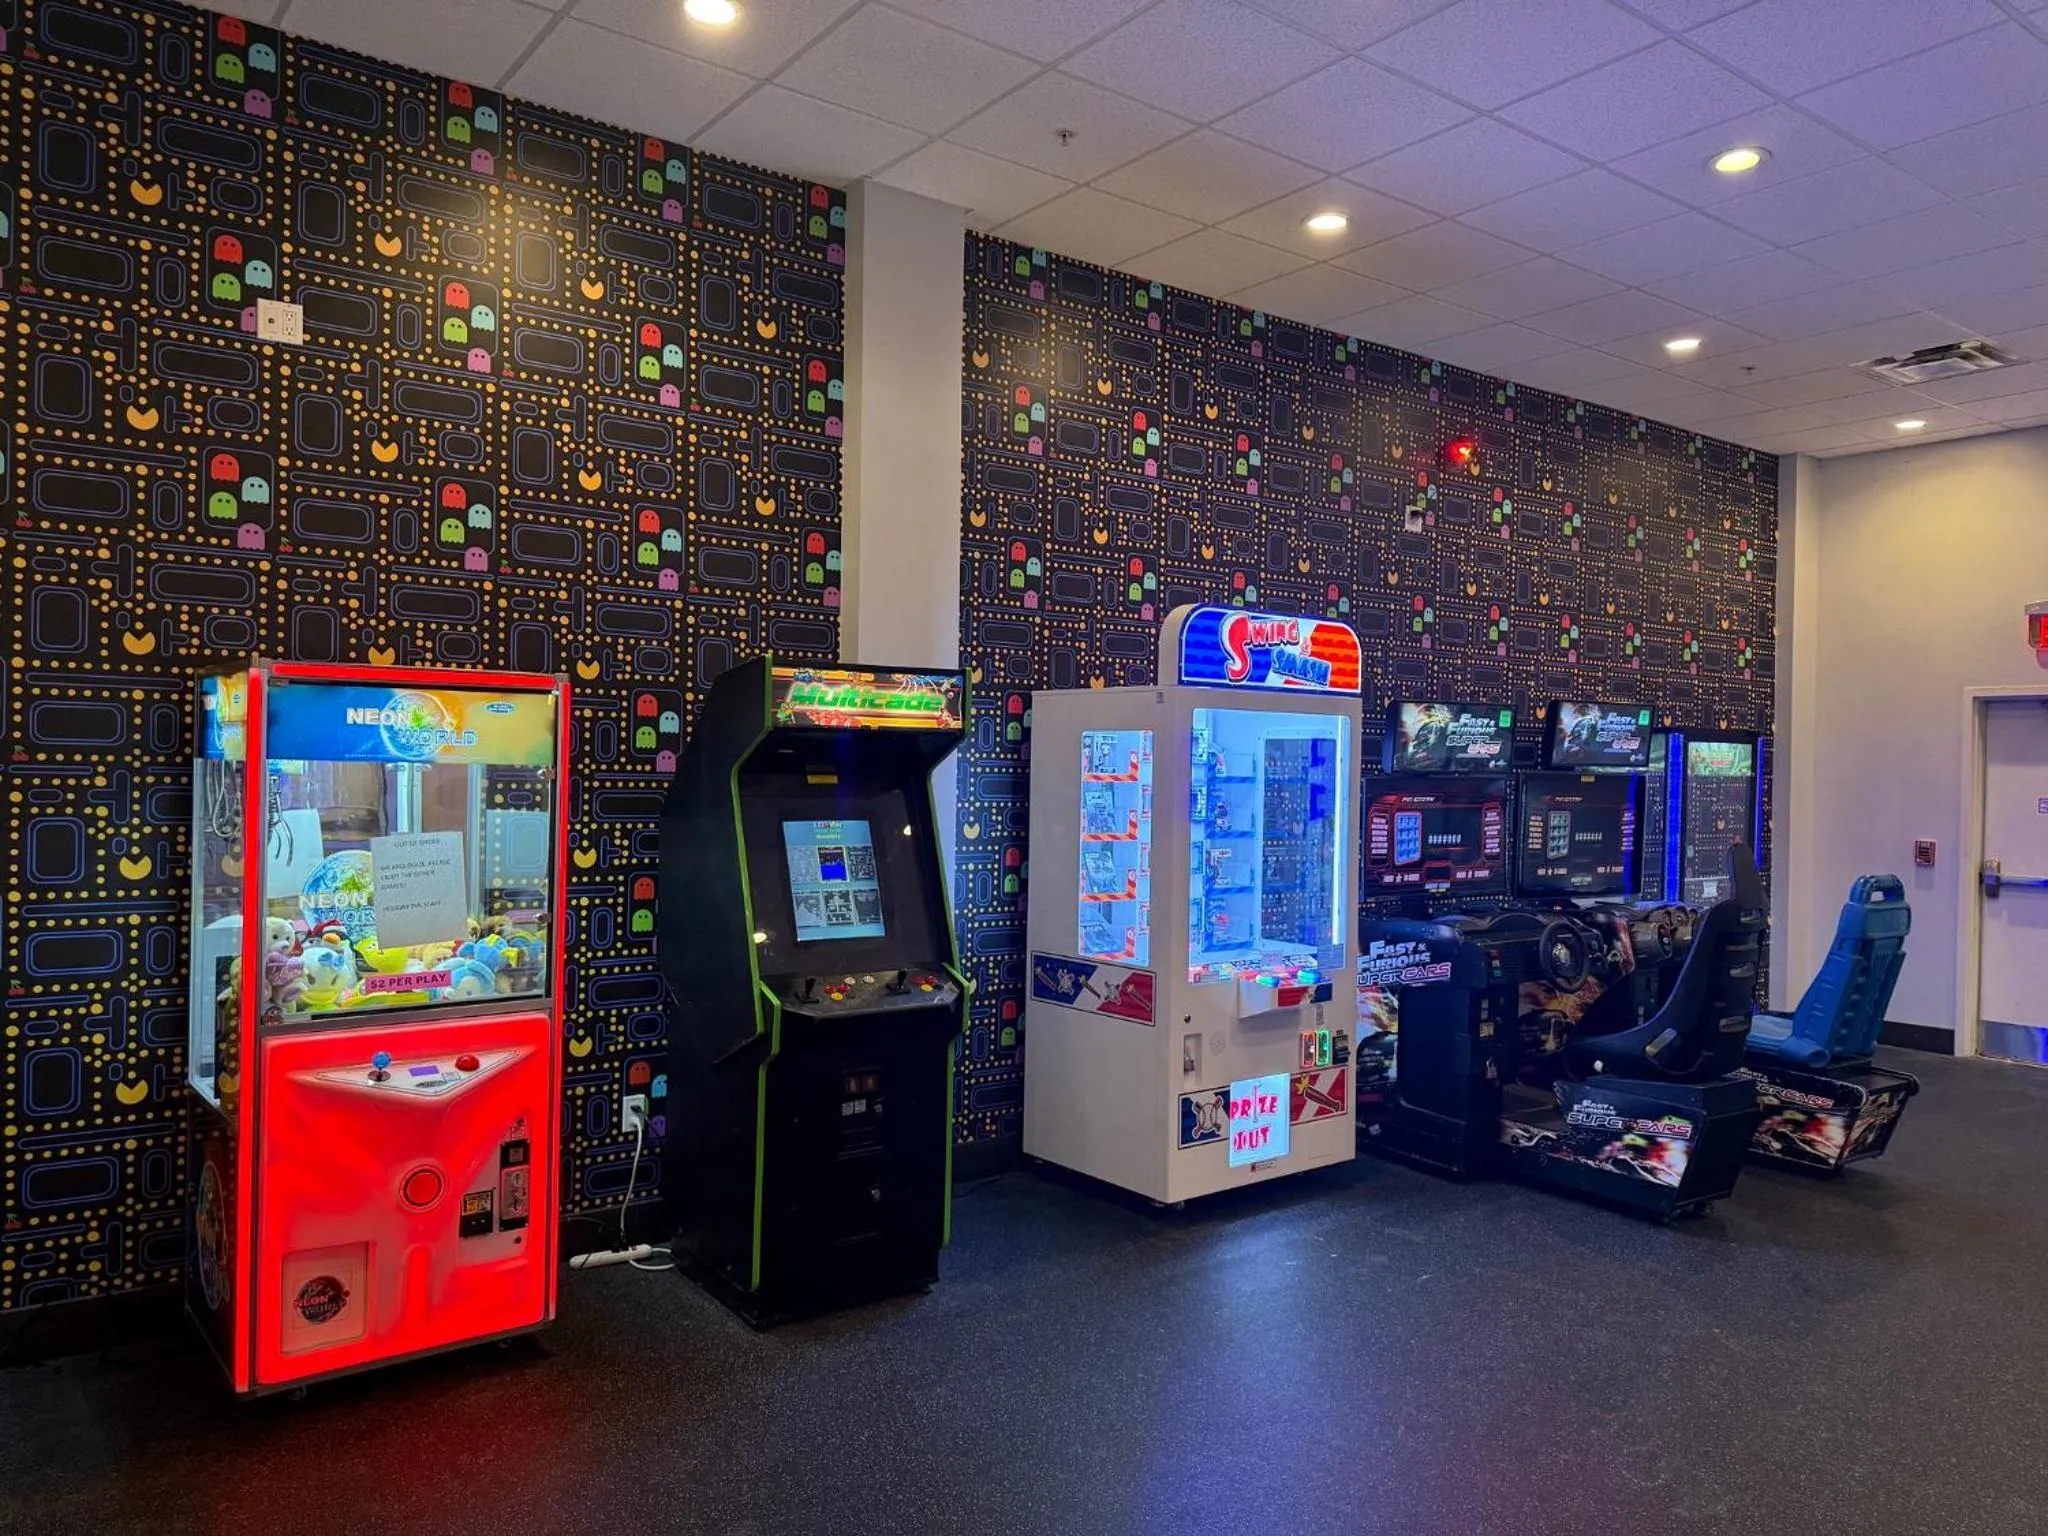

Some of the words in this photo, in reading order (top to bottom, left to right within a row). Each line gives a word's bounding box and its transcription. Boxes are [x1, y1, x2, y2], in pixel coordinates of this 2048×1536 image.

[1220, 611, 1299, 682] SWING
[1272, 646, 1331, 687] SMASH
[346, 707, 412, 728] NEON
[397, 728, 478, 746] WORLD
[299, 889, 369, 911] NEON
[389, 976, 412, 987] PER
[416, 973, 447, 984] PLAY
[1357, 962, 1451, 987] UPERCARS
